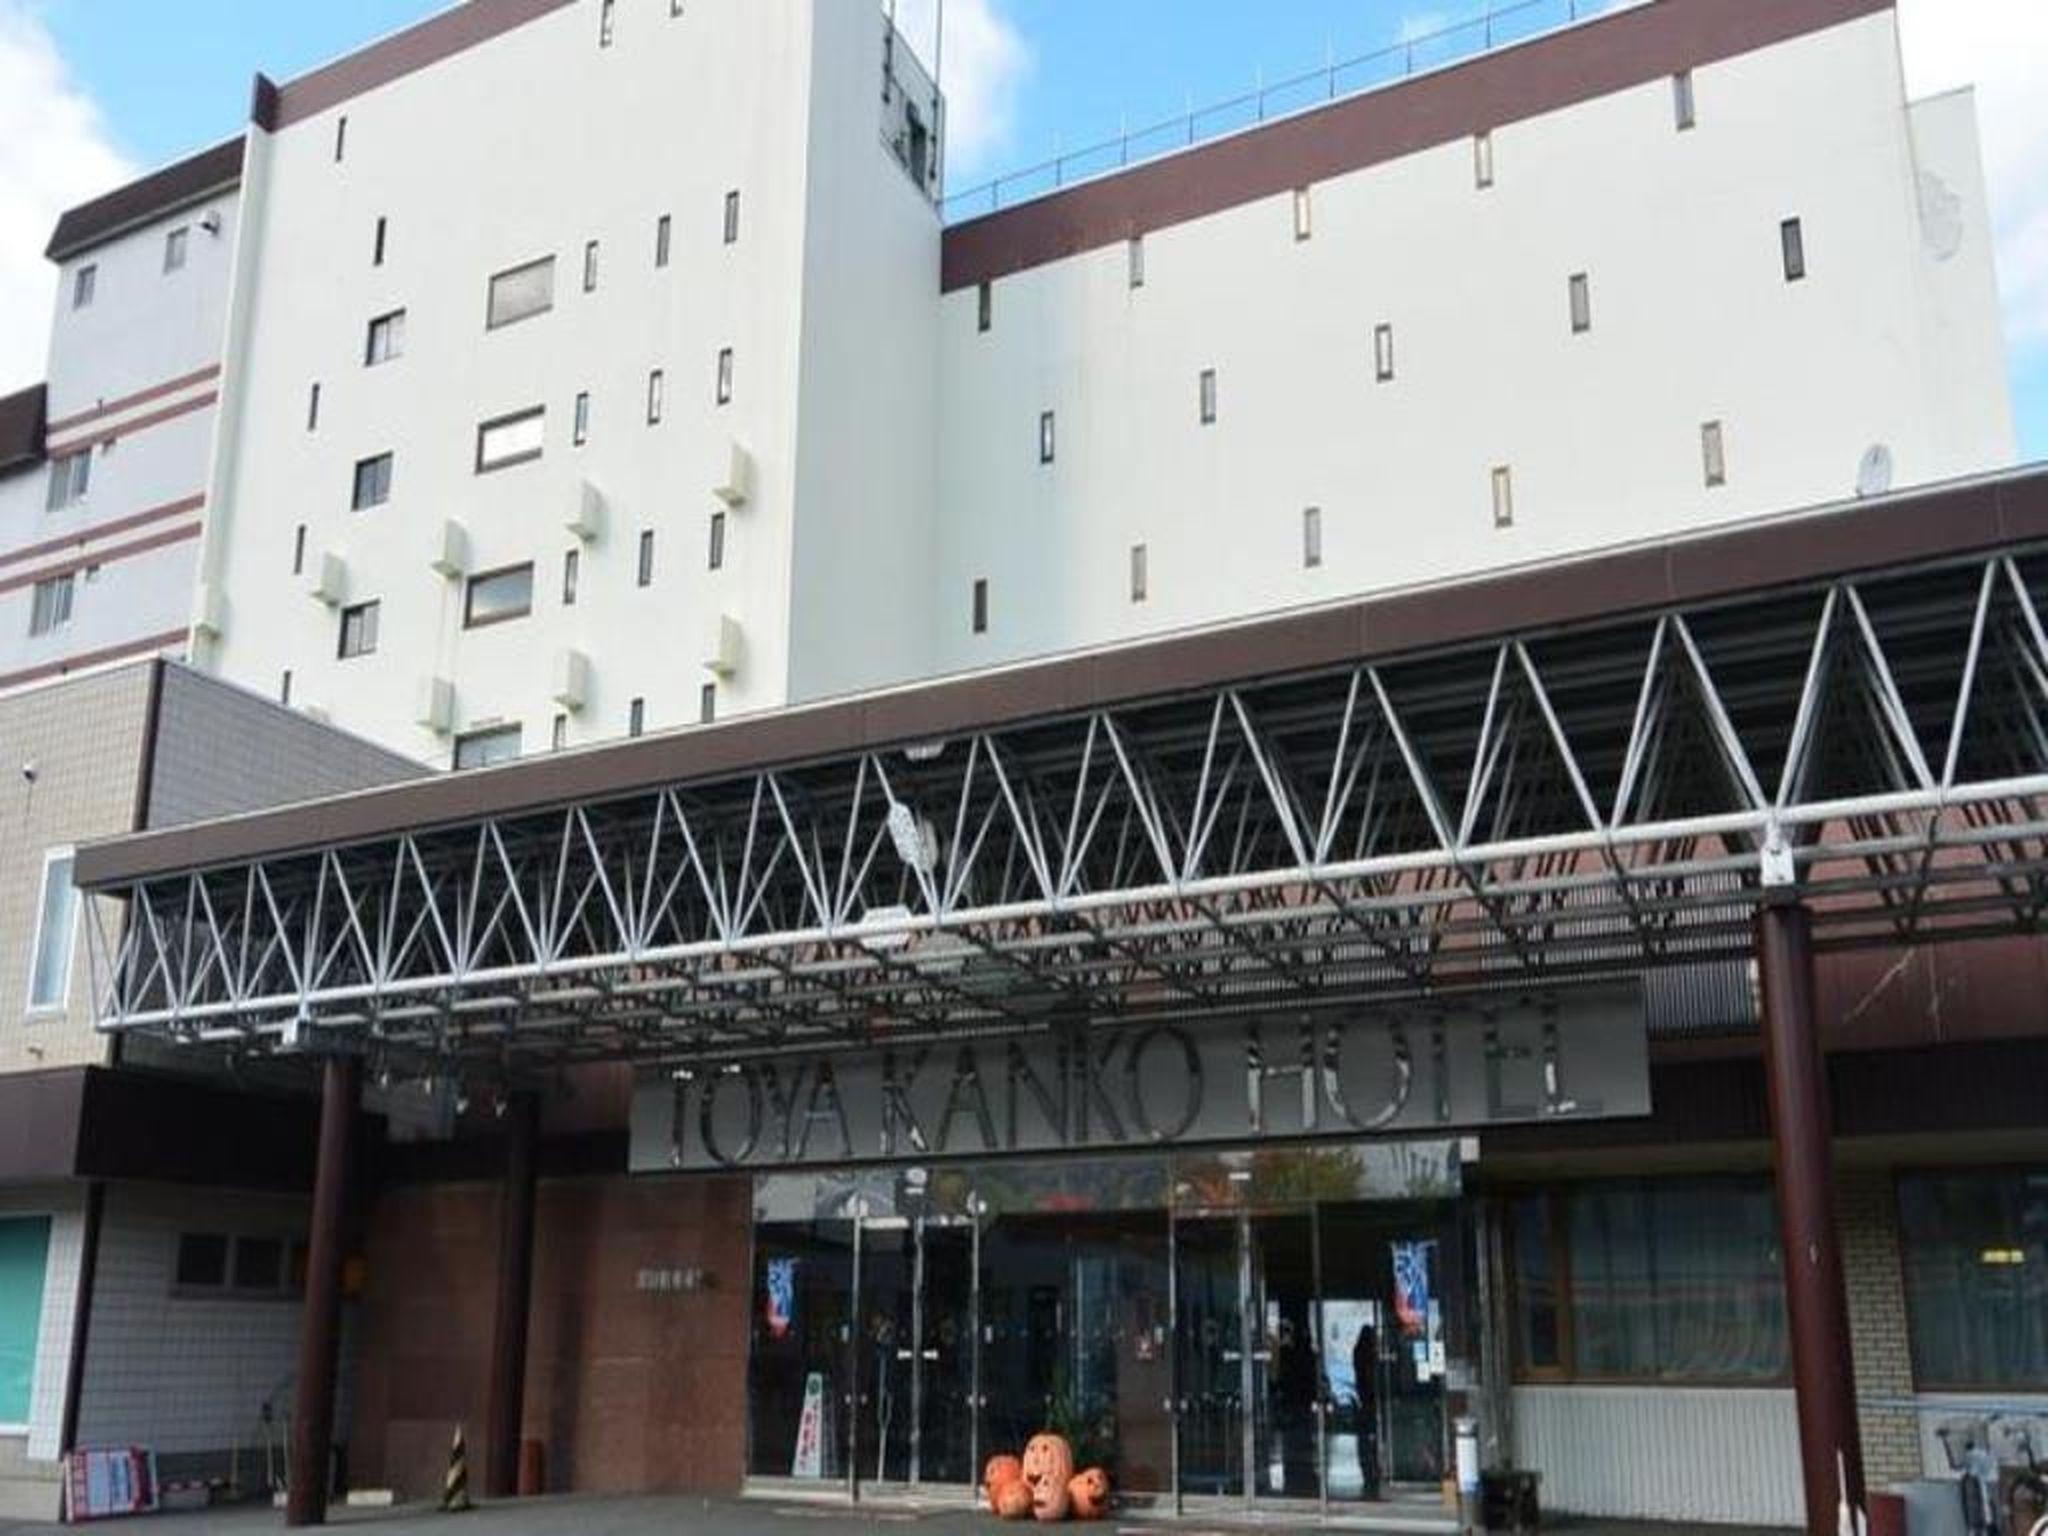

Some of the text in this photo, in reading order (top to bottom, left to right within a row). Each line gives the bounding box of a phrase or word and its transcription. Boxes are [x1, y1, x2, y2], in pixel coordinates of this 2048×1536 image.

[666, 998, 1578, 1165] TOYA KANKO HOTEL
